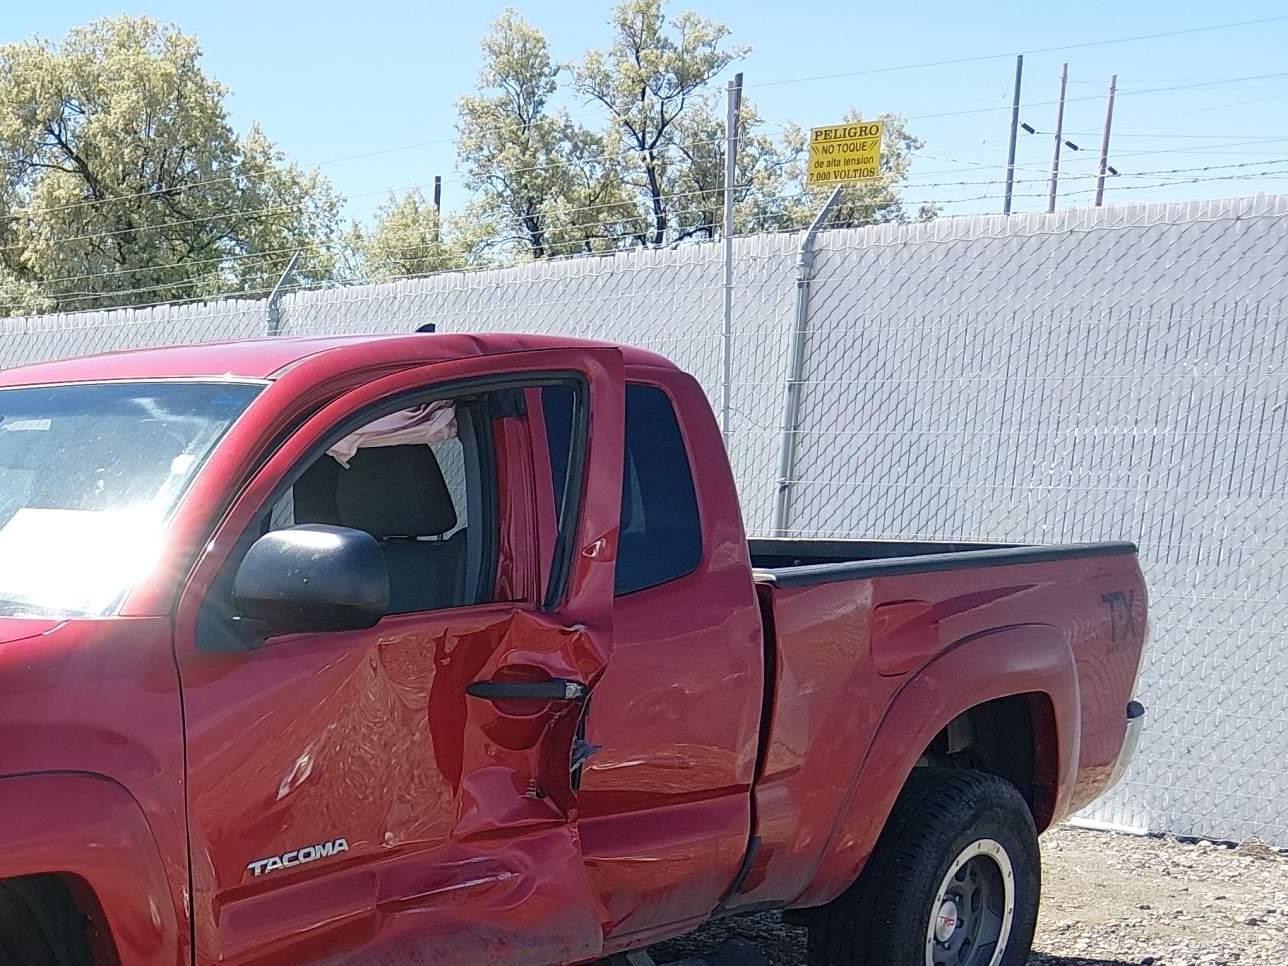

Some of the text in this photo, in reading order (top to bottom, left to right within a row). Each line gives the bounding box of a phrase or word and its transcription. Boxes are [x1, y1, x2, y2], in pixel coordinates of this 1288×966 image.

[814, 124, 879, 141] PELIGRO
[821, 141, 868, 155] NO TOQUE
[814, 155, 874, 169] de alta tension
[833, 167, 876, 180] VOLTIOS
[246, 838, 349, 877] TACOMA
[938, 915, 955, 928] TRD
